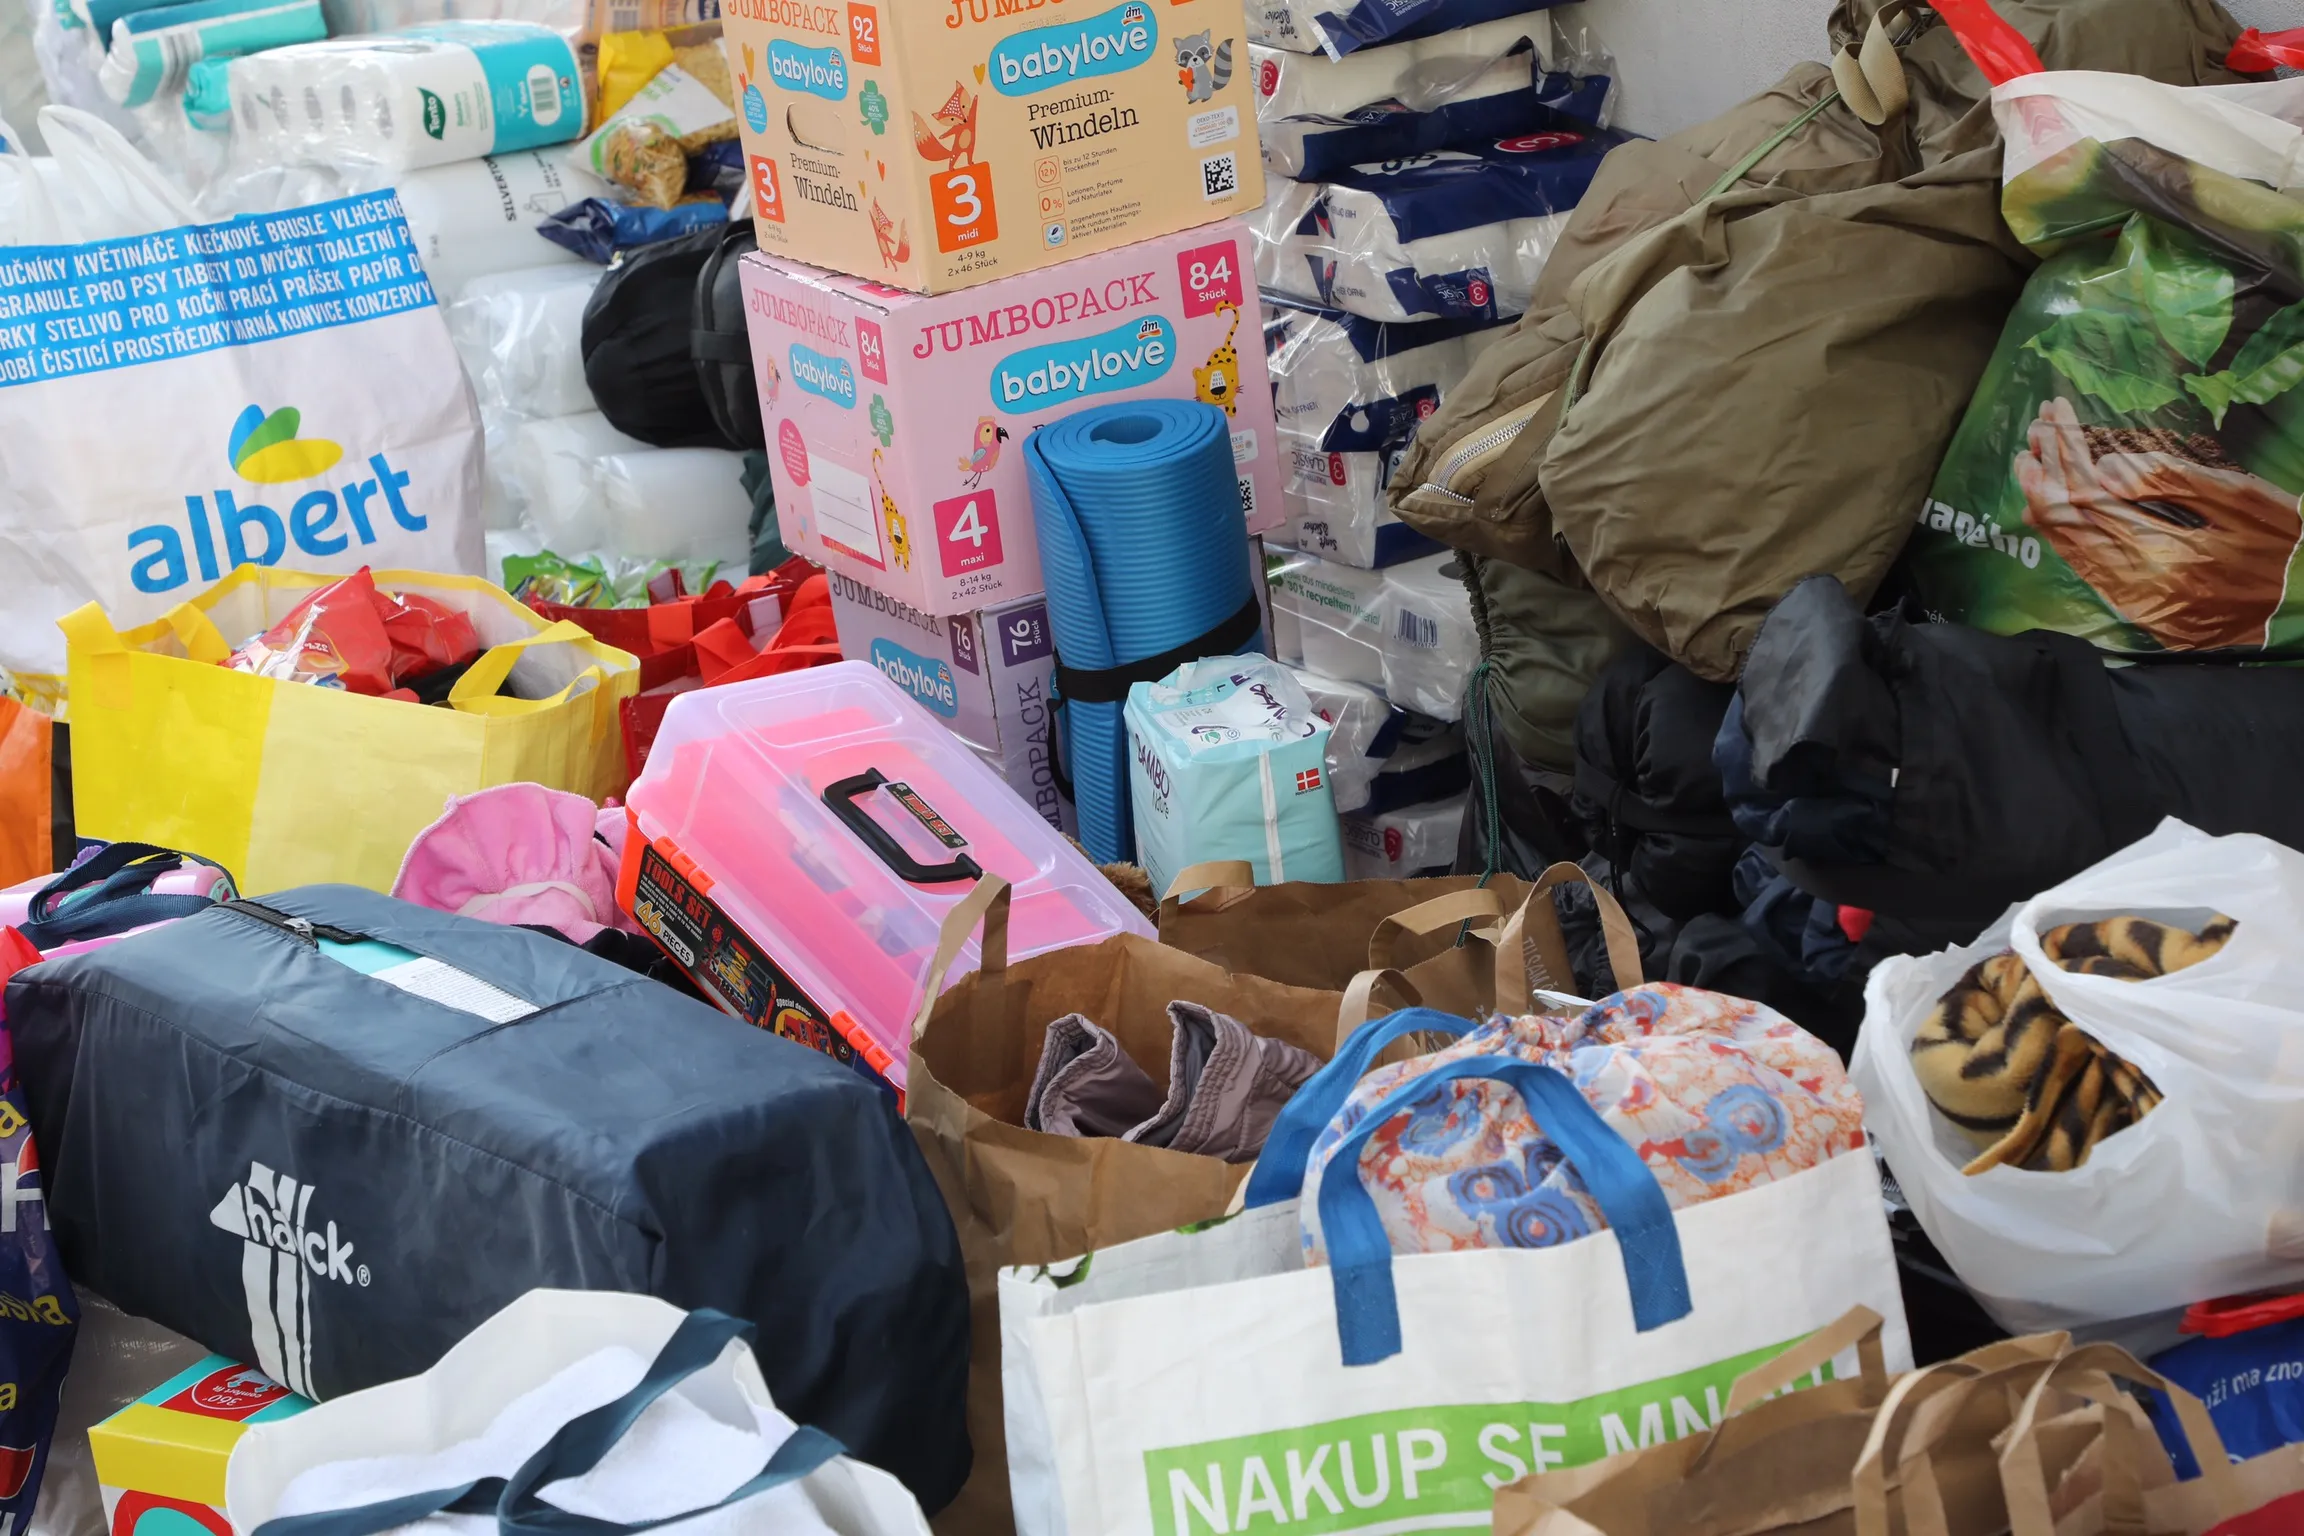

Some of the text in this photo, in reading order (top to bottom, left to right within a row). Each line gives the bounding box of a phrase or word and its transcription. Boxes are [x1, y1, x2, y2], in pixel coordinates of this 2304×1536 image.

[1126, 6, 1141, 19] dm
[853, 15, 874, 43] 92
[998, 25, 1149, 85] babylove
[771, 50, 844, 90] babylove
[428, 96, 444, 133] Tento
[1027, 88, 1115, 121] Premium-
[1030, 105, 1140, 150] Windeln
[790, 153, 840, 178] Premium-
[1063, 158, 1073, 166] bis
[1083, 154, 1090, 162] 12
[1091, 147, 1117, 159] Stunden
[1064, 159, 1100, 173] Trockenheit
[757, 162, 776, 203] 3
[793, 175, 858, 212] Windeln
[1067, 185, 1095, 197] Lotionen,
[1068, 188, 1113, 205] und Naturlatex
[947, 174, 982, 226] 3
[1070, 201, 1141, 224] angenehmes Hautklima
[957, 227, 979, 242] midi
[1071, 222, 1085, 232] dank
[1087, 217, 1111, 228] rundum
[1071, 220, 1127, 239] aktiver Materialien
[73, 236, 179, 277] KVĚTINÁČE
[266, 212, 327, 242] BRUSLE
[957, 250, 986, 262] 4-9 kg
[85, 279, 127, 305] PRO
[130, 271, 168, 298] PSY
[235, 258, 257, 279] DO
[260, 243, 315, 275] MYČKY
[315, 224, 397, 263] TOALETNÍ
[974, 257, 998, 270] Stück
[1188, 256, 1231, 290] 84
[45, 310, 123, 342] STELIVO
[129, 302, 169, 329] PRO
[229, 278, 279, 311] PRACÍ
[282, 268, 346, 300] PRÁŠEK
[348, 254, 404, 288] PAPÍR
[1198, 288, 1227, 302] Stück
[41, 339, 110, 375] ČISTICÍ
[112, 320, 231, 362] PROSTŘEDKY
[278, 299, 347, 333] KONVICE
[346, 279, 432, 321] KONZERVY
[751, 287, 851, 349] JUMBOPACK
[912, 271, 1159, 360] JUMBOPACK
[1140, 319, 1159, 334] dm
[860, 331, 881, 360] 84
[792, 353, 853, 399] babylove
[1001, 340, 1165, 402] babylove
[128, 453, 428, 594] albert
[949, 500, 989, 548] 4
[960, 552, 985, 567] maxi
[959, 573, 992, 587] 8-14 kg
[979, 580, 1003, 593] Stück
[1302, 574, 1314, 585] aus
[1315, 578, 1356, 600] mindestens
[1306, 589, 1352, 611] recyceltem
[952, 622, 971, 652] 76
[1009, 618, 1033, 656] 76
[1031, 619, 1042, 645] Stück
[875, 648, 955, 708] babylove
[645, 855, 685, 905] TOOLS
[685, 894, 712, 929] SET
[637, 899, 664, 935] 46
[662, 929, 691, 962] PIECES
[776, 998, 795, 1009] special
[212, 1384, 262, 1399] comfort fit
[2232, 1368, 2261, 1395] ma
[1167, 1429, 1449, 1536] NAKUP
